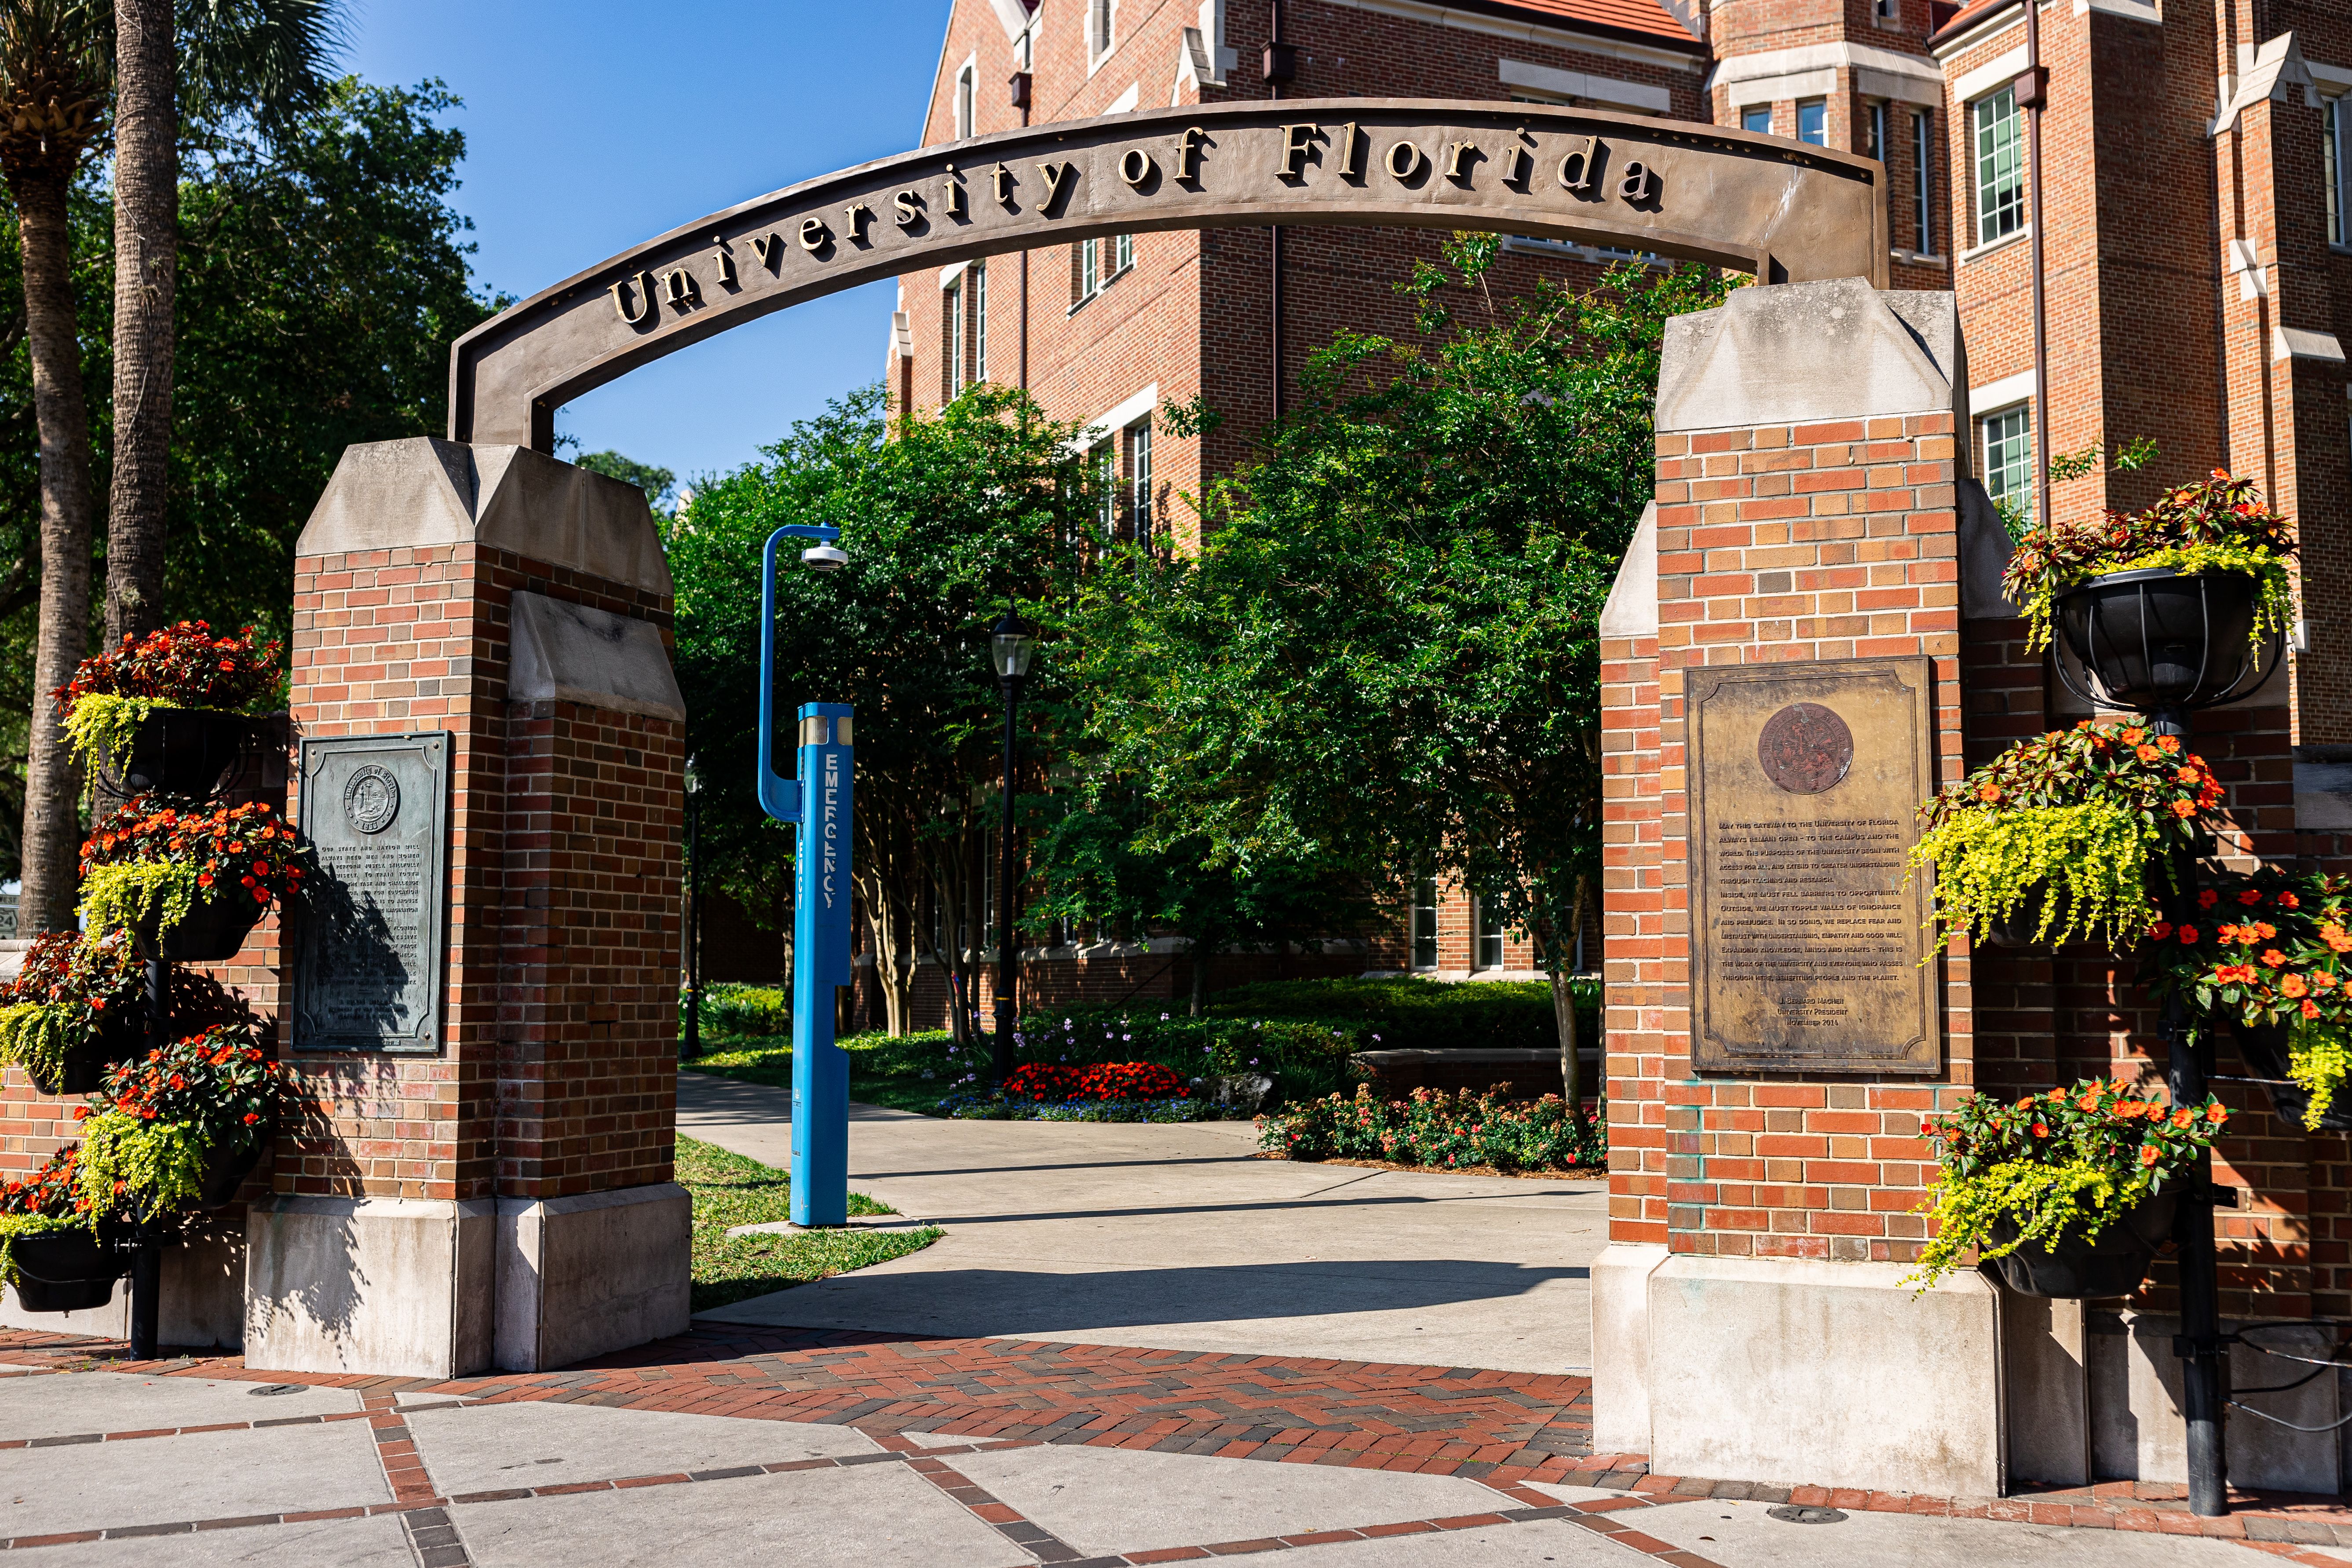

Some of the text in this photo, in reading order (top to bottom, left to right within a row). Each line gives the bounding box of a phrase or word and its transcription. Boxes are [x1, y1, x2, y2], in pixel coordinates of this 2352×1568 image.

[607, 121, 1649, 325] University of Florida
[345, 767, 373, 800] University
[375, 767, 382, 775] of
[380, 771, 396, 798] Florida
